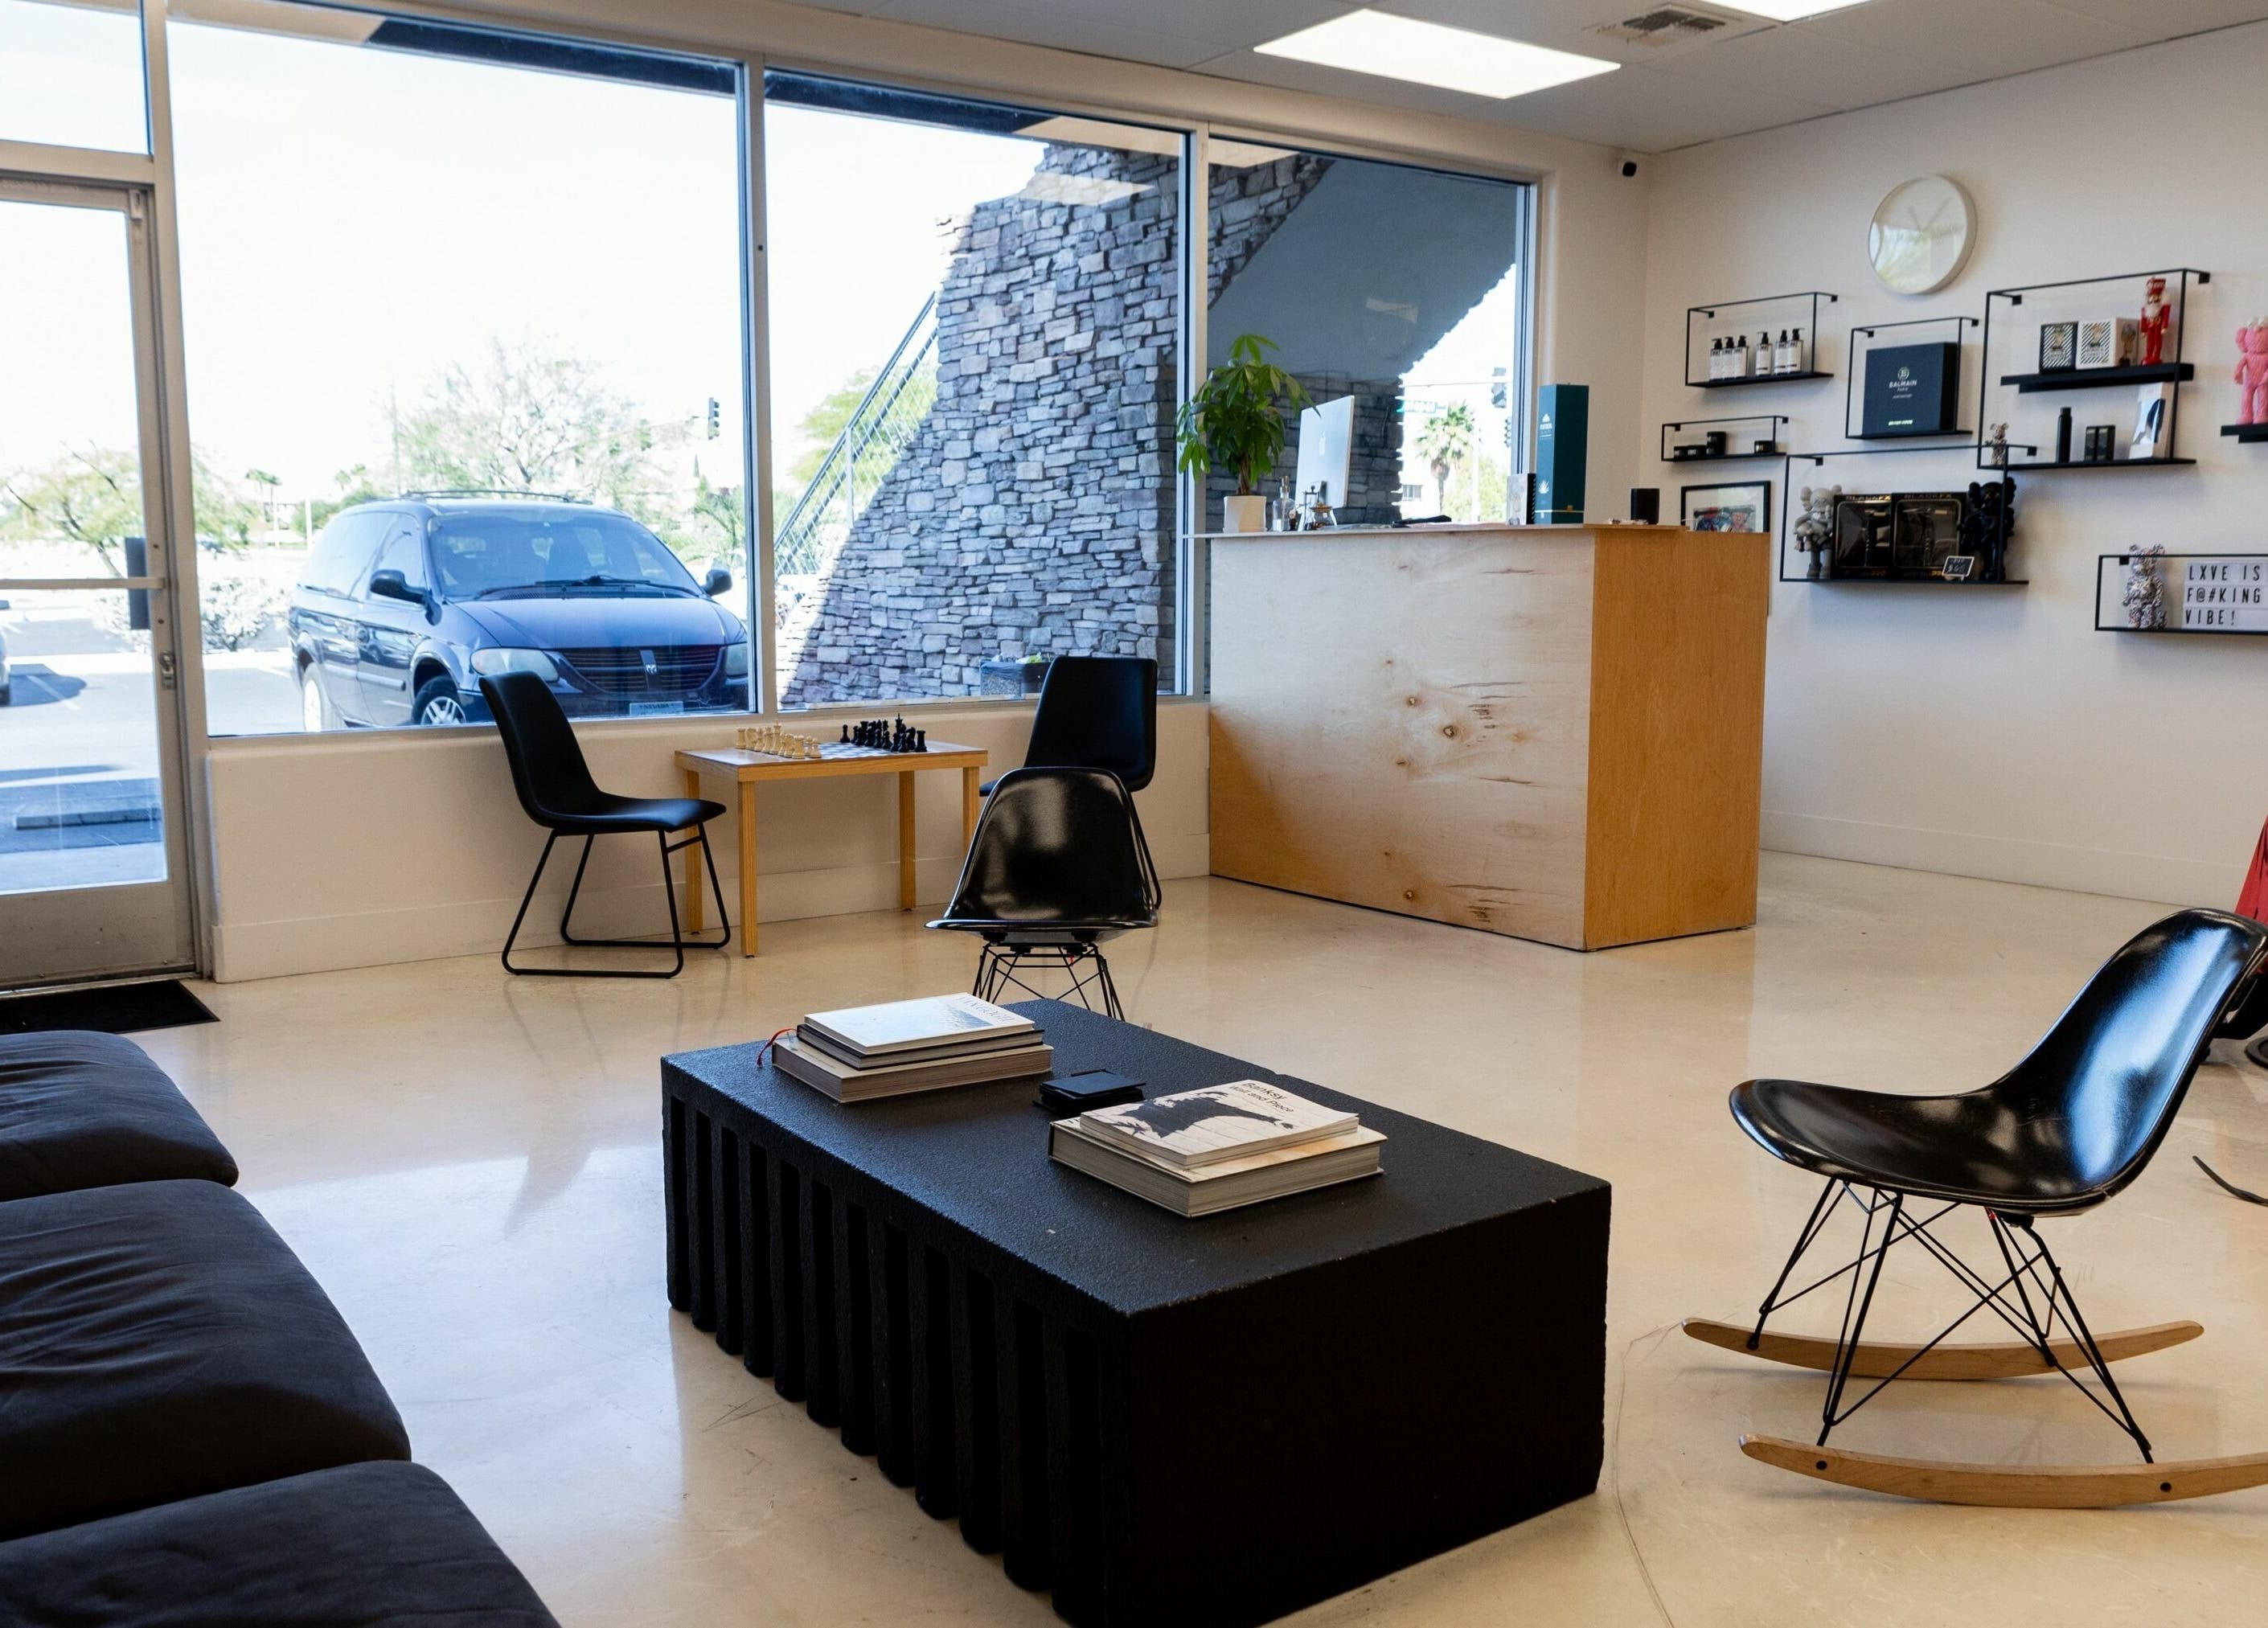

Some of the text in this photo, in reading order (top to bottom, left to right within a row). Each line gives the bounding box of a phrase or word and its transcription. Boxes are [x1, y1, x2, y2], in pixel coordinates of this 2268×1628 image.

[1889, 379, 1917, 388] BALMAIN
[2188, 565, 2261, 581] LXVE IS
[2186, 587, 2261, 603] F@#KING
[2185, 609, 2235, 625] VIBE!
[1241, 1082, 1287, 1100] Banksy
[1248, 1093, 1269, 1101] and
